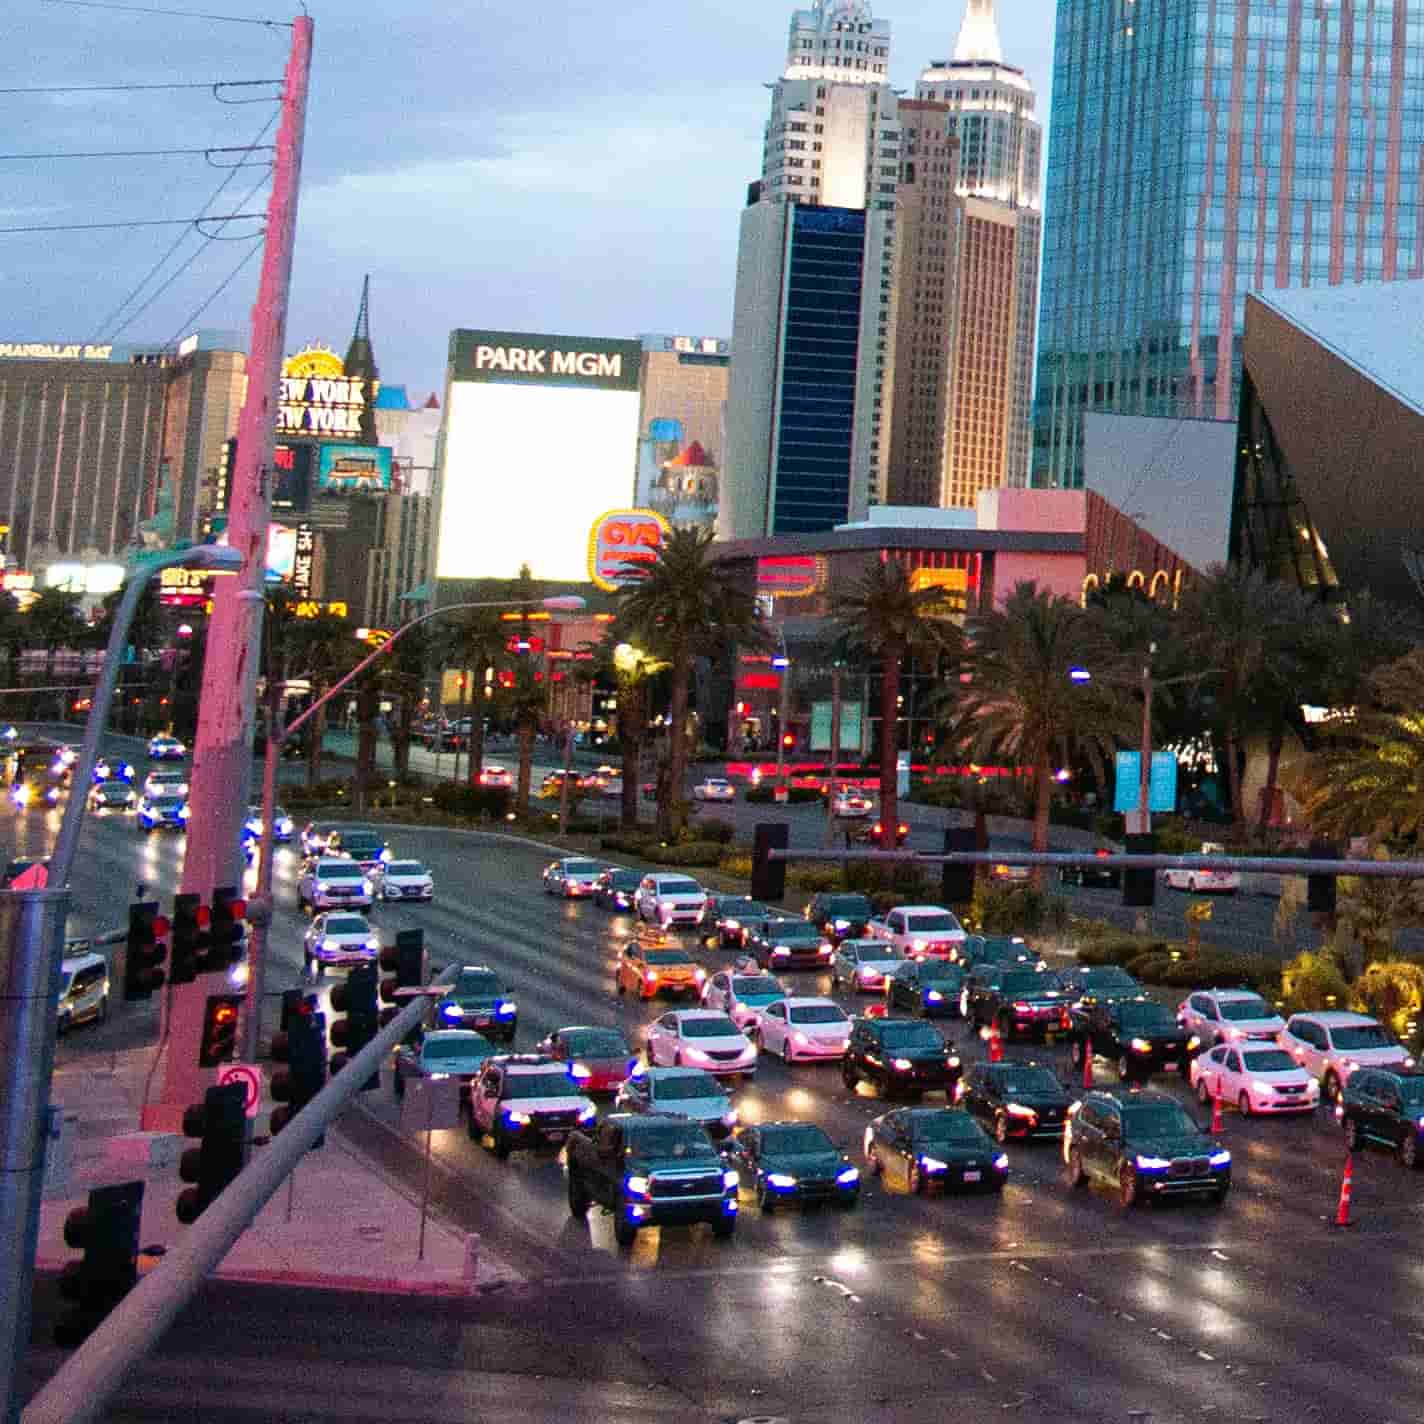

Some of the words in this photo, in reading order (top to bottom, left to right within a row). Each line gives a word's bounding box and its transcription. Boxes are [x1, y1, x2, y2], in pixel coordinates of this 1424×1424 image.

[474, 345, 546, 373] PARK
[550, 350, 622, 377] MGM
[279, 378, 308, 402] EW
[310, 379, 365, 404] YORK
[276, 405, 305, 430] EW
[309, 406, 362, 432] YORK
[602, 522, 659, 547] CVS
